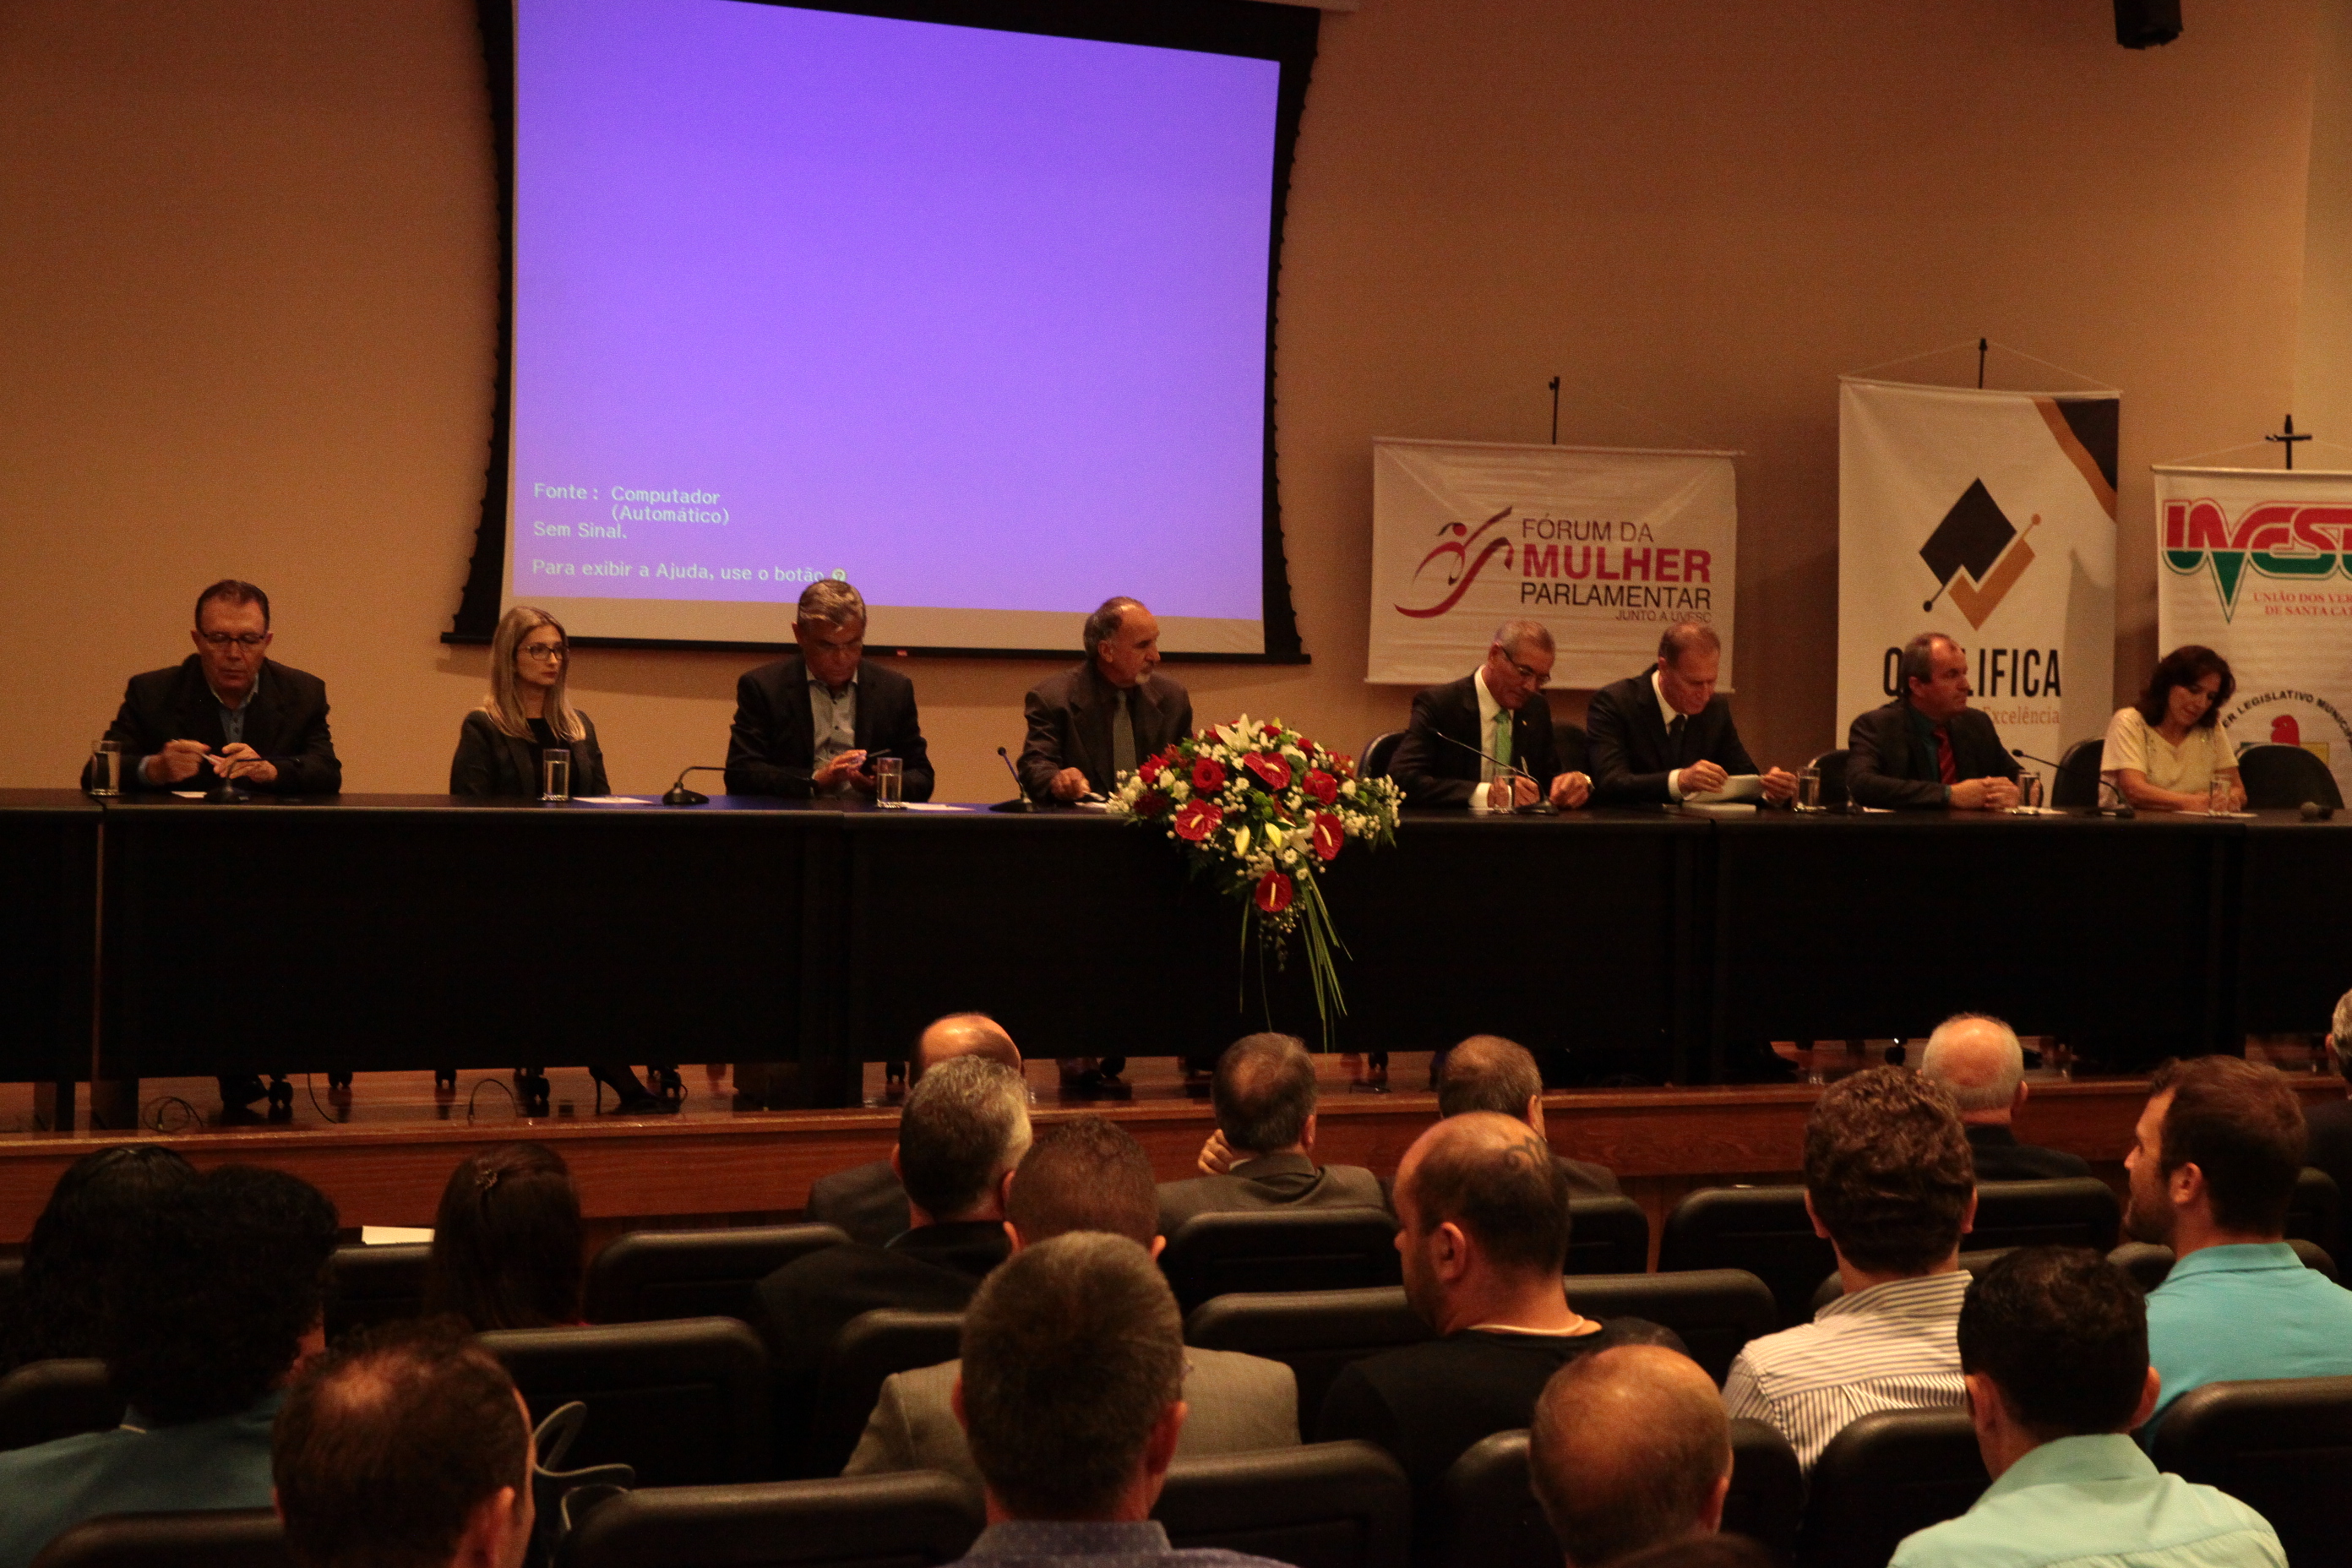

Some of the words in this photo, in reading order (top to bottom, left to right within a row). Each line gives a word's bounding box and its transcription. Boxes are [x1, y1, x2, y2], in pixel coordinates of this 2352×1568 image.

[611, 486, 721, 505] Computador
[611, 505, 730, 525] (Automático)
[532, 521, 571, 538] Sem
[577, 522, 628, 540] Sinal.
[1522, 513, 1612, 542] FÓRUM
[1620, 522, 1654, 543] DA
[531, 558, 576, 577] Para
[581, 560, 633, 578] exibir
[639, 565, 650, 578] a
[655, 562, 715, 580] Ajuda,
[720, 568, 753, 581] use
[758, 569, 770, 581] o
[774, 565, 825, 583] botão
[1522, 543, 1712, 583] MULHER
[1521, 582, 1712, 610] PARLAMENTAR
[2253, 590, 2296, 602] UNIÃO
[1615, 609, 1657, 622] JUNTO
[1659, 611, 1669, 622] A
[1883, 646, 2061, 697] QIFICA
[2236, 689, 2313, 715] LEGISLATIVO
